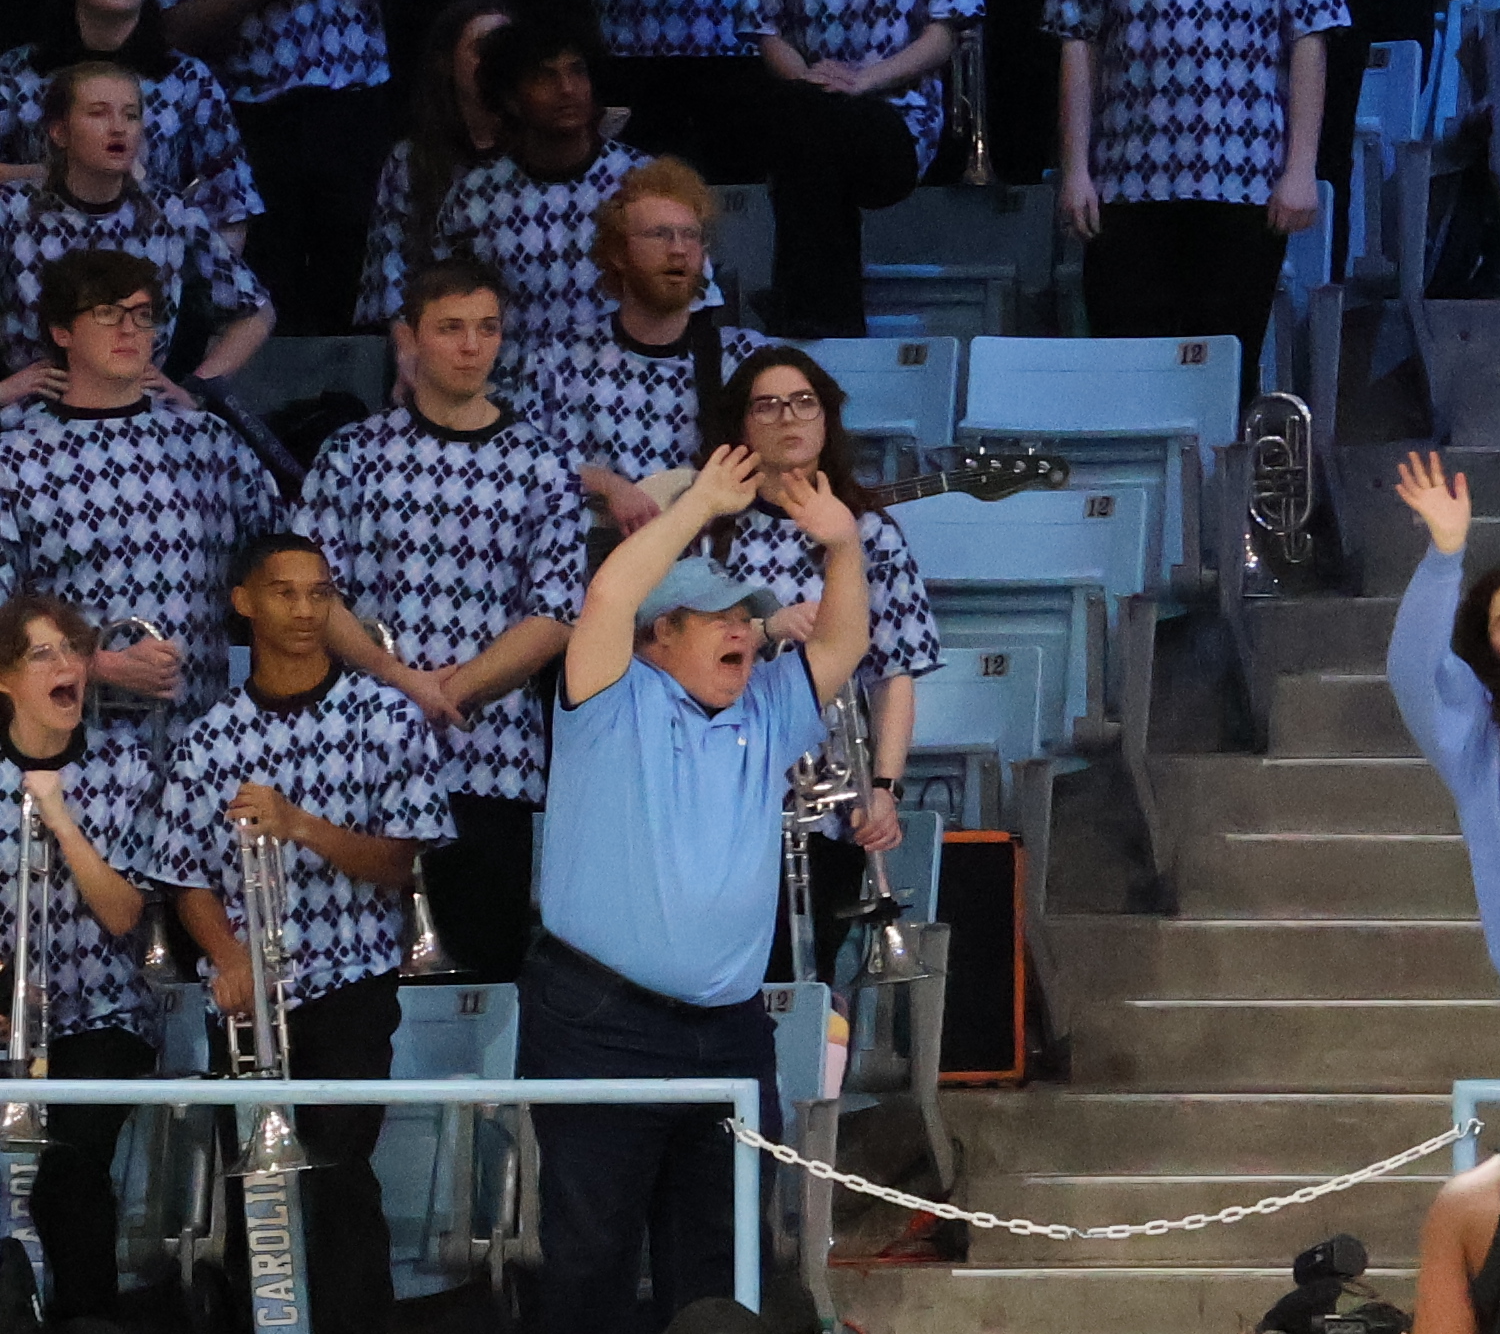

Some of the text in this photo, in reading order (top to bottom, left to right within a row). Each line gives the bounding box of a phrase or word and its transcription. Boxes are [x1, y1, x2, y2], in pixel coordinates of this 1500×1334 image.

[1180, 344, 1203, 365] 12
[1086, 496, 1113, 517] 12
[982, 654, 1004, 676] 12
[459, 991, 481, 1014] 11
[765, 990, 788, 1013] 12
[243, 1170, 299, 1327] CAROLIN
